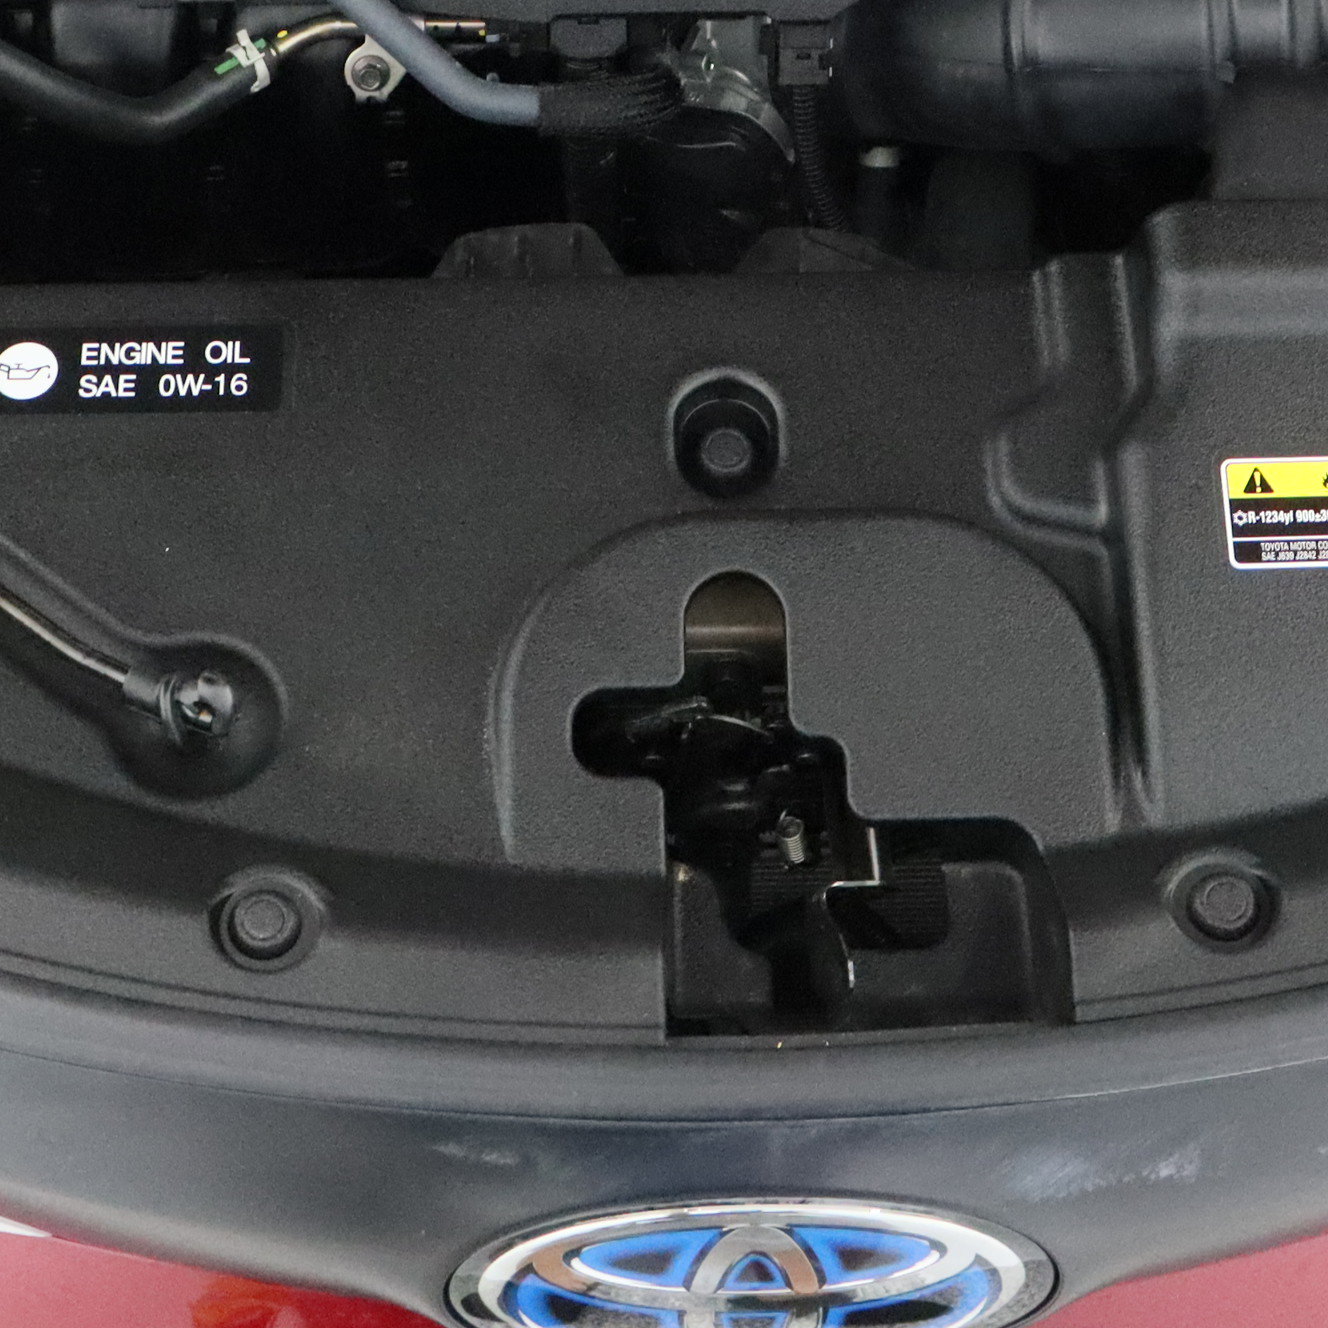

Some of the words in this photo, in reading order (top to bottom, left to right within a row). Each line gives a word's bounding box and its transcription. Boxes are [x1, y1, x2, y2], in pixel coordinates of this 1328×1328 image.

[80, 341, 185, 366] ENGINE
[204, 340, 251, 364] OIL
[78, 373, 137, 398] SAE
[158, 372, 249, 397] 0W-16
[1260, 541, 1289, 551] TOYOTA
[1290, 541, 1317, 550] MOTOR
[1261, 551, 1276, 561] SAE
